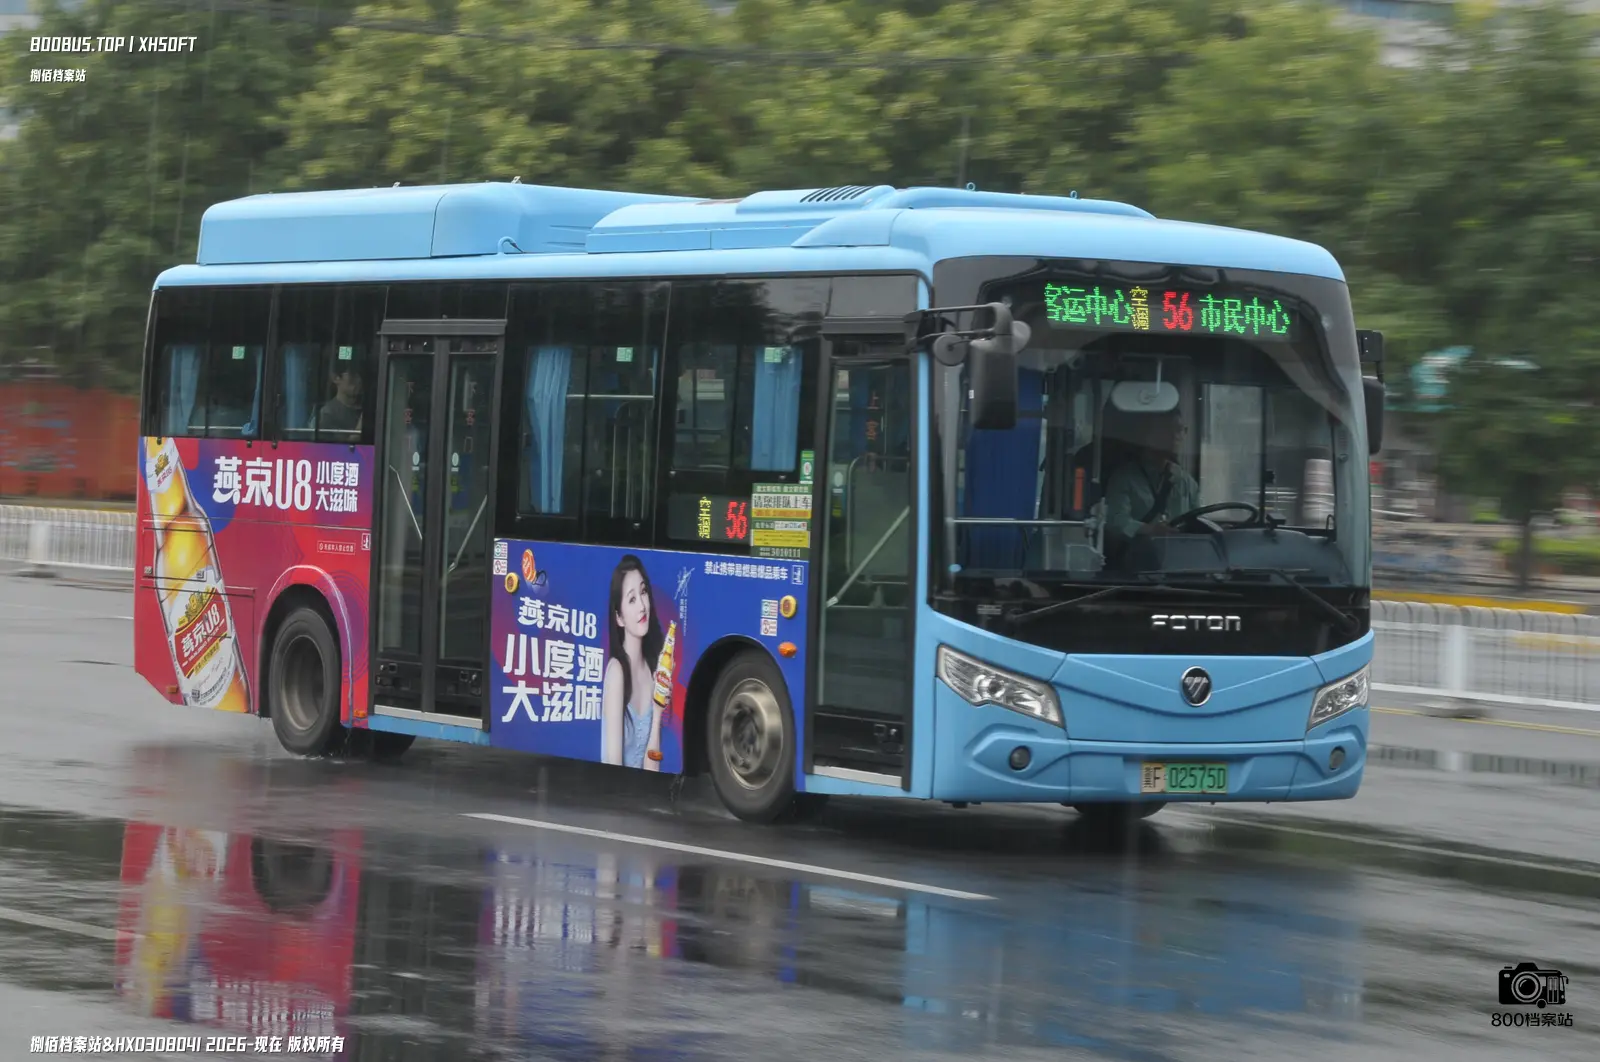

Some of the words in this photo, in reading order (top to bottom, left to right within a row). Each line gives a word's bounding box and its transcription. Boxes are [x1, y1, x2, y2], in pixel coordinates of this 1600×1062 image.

[1163, 291, 1194, 331] 56
[1199, 293, 1291, 335] 市民中心
[212, 455, 312, 510] 燕京U8
[315, 461, 360, 486] 小度酒
[315, 487, 358, 513] 大滋味
[725, 501, 748, 540] 56
[516, 596, 597, 640] 燕京U8
[1151, 614, 1242, 632] FOTON
[502, 633, 605, 683] 小度酒
[501, 680, 603, 723] 大滋味
